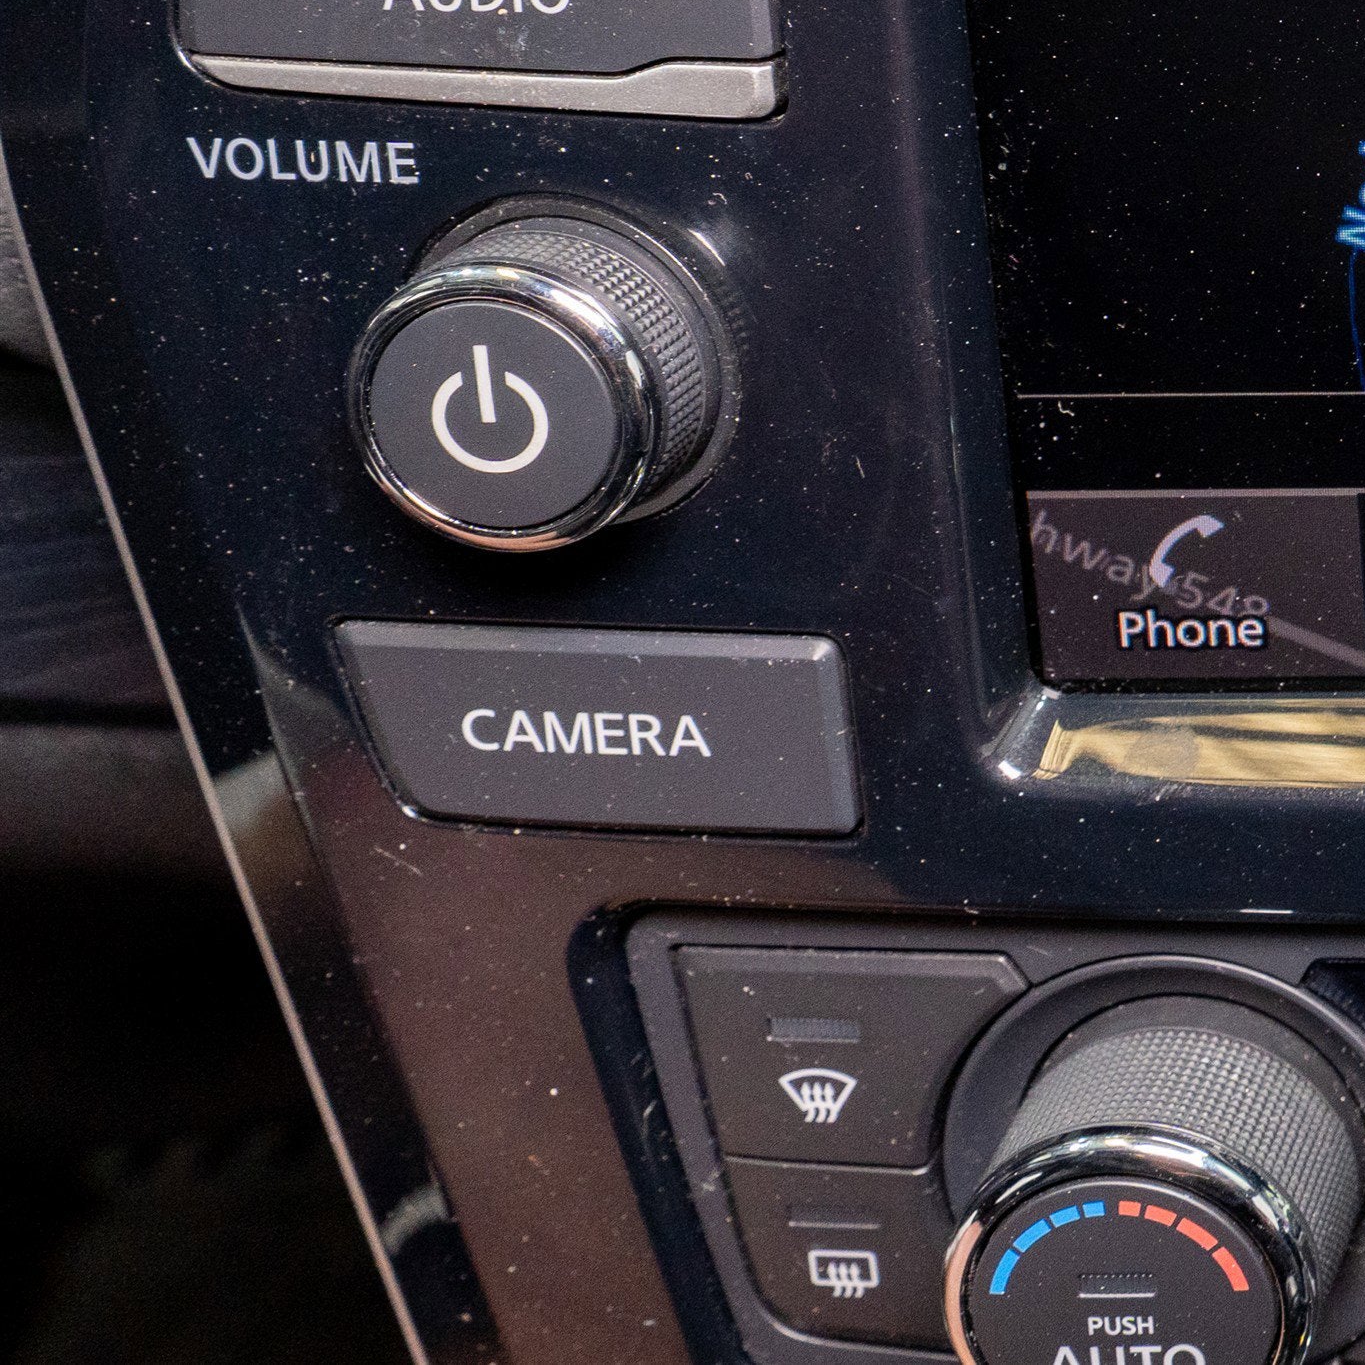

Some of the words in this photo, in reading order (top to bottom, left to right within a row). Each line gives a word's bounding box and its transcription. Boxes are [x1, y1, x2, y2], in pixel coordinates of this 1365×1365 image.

[186, 137, 420, 185] VOLUME
[1118, 609, 1265, 649] Phone
[461, 707, 711, 758] CAMERA
[1087, 1315, 1154, 1336] PUSH
